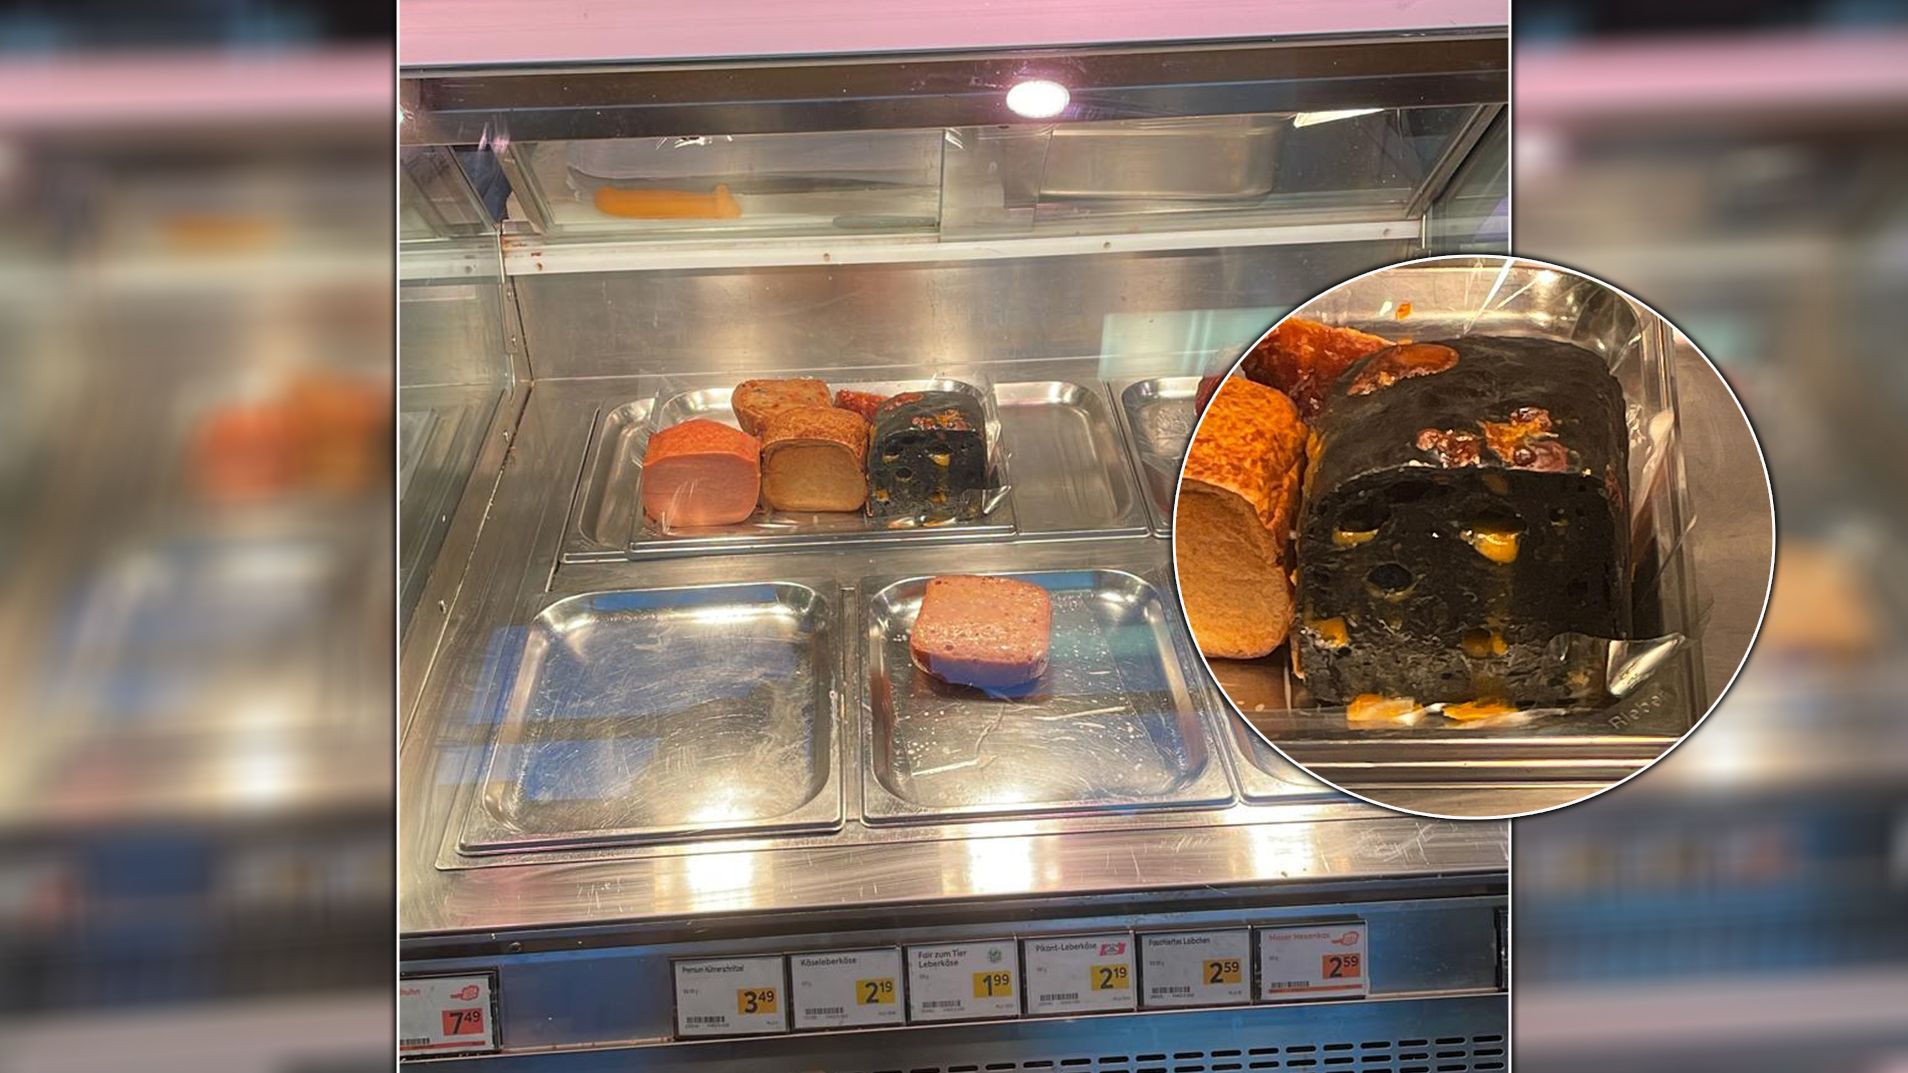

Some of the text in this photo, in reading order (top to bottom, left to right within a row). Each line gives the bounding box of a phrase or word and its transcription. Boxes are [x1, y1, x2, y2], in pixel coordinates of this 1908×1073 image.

[918, 947, 967, 958] Fair zum Tier
